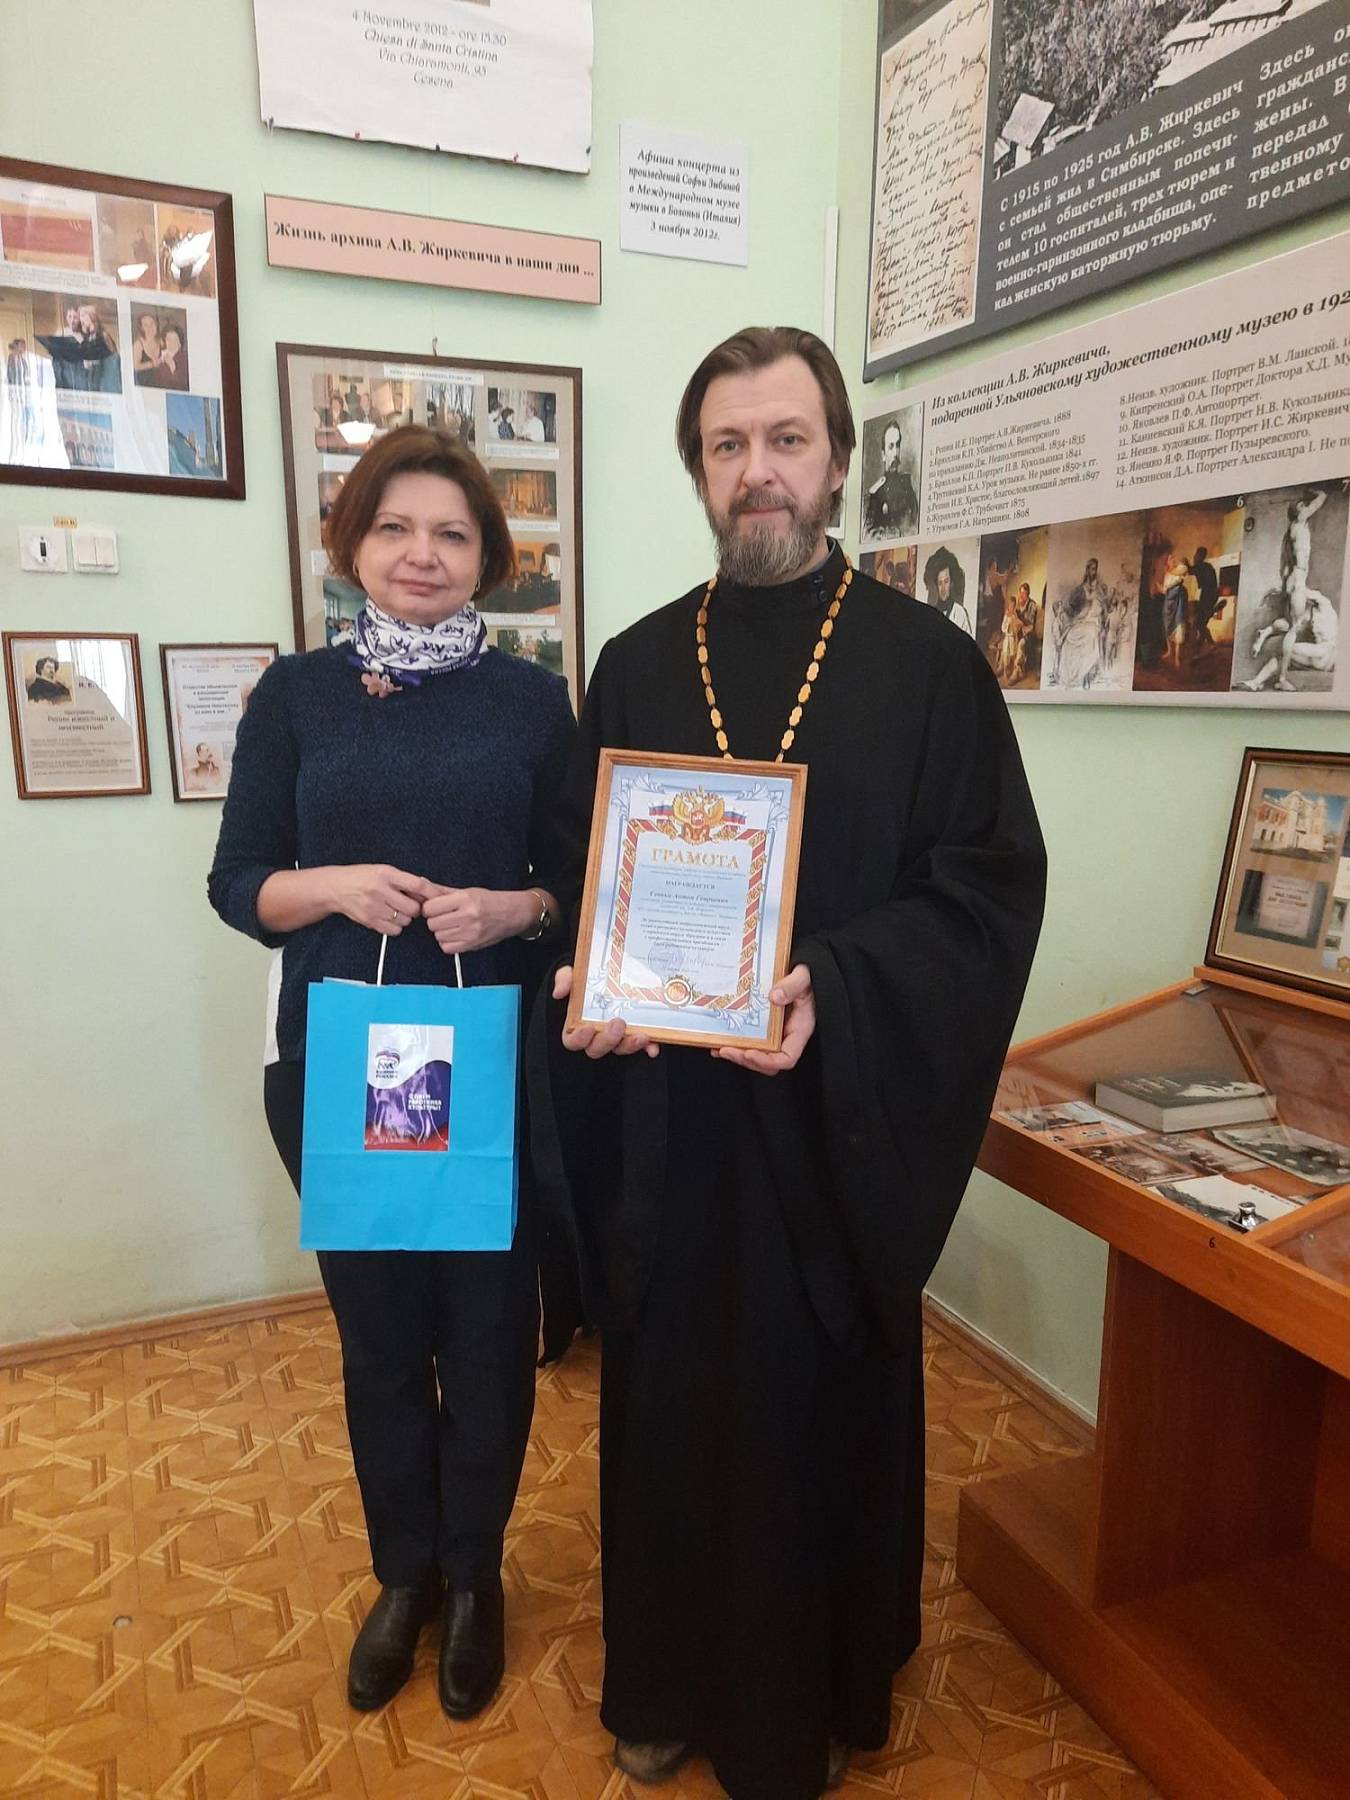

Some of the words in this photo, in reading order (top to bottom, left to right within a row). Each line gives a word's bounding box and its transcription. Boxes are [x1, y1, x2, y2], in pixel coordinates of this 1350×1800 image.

[364, 28, 402, 46] Chiesa
[406, 36, 417, 49] di
[420, 39, 452, 54] Santa
[455, 45, 498, 62] Cristina
[424, 22, 448, 36] 2012
[378, 47, 396, 63] Via
[1259, 43, 1315, 81] Здесь
[413, 71, 453, 89] Cesena
[1256, 52, 1350, 109] гражданс
[1253, 97, 1313, 134] жены.
[1332, 75, 1347, 97] В
[1000, 197, 1009, 213] С
[1013, 181, 1040, 207] 1915
[1044, 175, 1059, 192] по
[1063, 153, 1094, 182] 1925
[1097, 143, 1121, 164] год
[1125, 125, 1153, 150] А.В.
[1158, 79, 1244, 134] Жиркевич
[1251, 114, 1329, 159] передал
[628, 166, 681, 183] произведений
[637, 148, 675, 166] Афиша
[677, 158, 726, 175] концерта
[729, 166, 740, 176] из
[999, 221, 1006, 233] с
[1010, 195, 1052, 228] семьей
[1056, 184, 1082, 205] жил
[1086, 177, 1095, 191] в
[1100, 135, 1185, 183] Симбирске.
[1192, 107, 1241, 139] Здесь
[1248, 132, 1344, 185] твенному
[629, 184, 635, 193] в
[637, 183, 713, 205] Международном
[715, 198, 741, 210] музее
[997, 237, 1012, 252] он
[1021, 221, 1047, 241] стал
[1056, 167, 1161, 225] общественным
[1174, 132, 1238, 171] попечи-
[629, 201, 660, 214] музыки
[702, 210, 741, 227] (Италия)
[650, 221, 656, 232] 3
[658, 222, 691, 238] ноября
[692, 227, 720, 241] 2012г.
[996, 248, 1031, 272] телем
[1033, 238, 1048, 256] 10
[1050, 201, 1128, 249] госпиталей,
[1131, 188, 1164, 213] трех
[1167, 162, 1221, 196] тюрем
[1224, 156, 1236, 172] и
[273, 222, 327, 242] Жизнь
[330, 232, 382, 251] архива
[386, 237, 416, 255] А.В.
[420, 240, 502, 265] Жиркевича
[505, 255, 513, 265] в
[516, 258, 553, 272] наши
[556, 263, 581, 276] дни
[995, 230, 1120, 292] военно-гарнизонного
[1122, 199, 1196, 238] кладбища,
[1200, 183, 1234, 205] опе-
[994, 295, 1013, 311] кал
[1014, 272, 1069, 303] женскую
[1070, 239, 1149, 281] каторжную
[1150, 211, 1217, 248] тюрьму.
[931, 398, 993, 427] подаренной
[995, 371, 1083, 408] Ульяновскому
[1085, 326, 1232, 382] художественному
[1236, 306, 1298, 336] музею
[1302, 300, 1314, 316] в
[931, 396, 946, 411] Из
[948, 379, 1004, 406] коллекции
[1006, 368, 1030, 388] А.В.
[1032, 345, 1111, 380] Жиркевича,
[1212, 362, 1256, 382] Портрет
[1284, 339, 1340, 363] Ланской.
[1130, 394, 1186, 417] Кипренский
[1211, 378, 1254, 397] Портрет
[1255, 366, 1303, 386] Доктора
[1132, 414, 1170, 431] Яковлев
[1172, 406, 1193, 421] П.Ф.
[1195, 391, 1262, 415] Автопортрет.
[1210, 409, 1253, 427] Портрет
[969, 432, 996, 446] Портрет
[1186, 445, 1228, 462] Портрет
[1230, 429, 1311, 453] Пузыревского.
[1215, 422, 1259, 441] Портрет
[976, 466, 1004, 480] Портрет
[1196, 457, 1239, 474] Портрет
[1239, 445, 1305, 465] Александра
[1319, 437, 1337, 451] Не
[1236, 494, 1245, 509] 6
[650, 847, 741, 870] ГРАМОТА
[1208, 1236, 1216, 1249] 6
